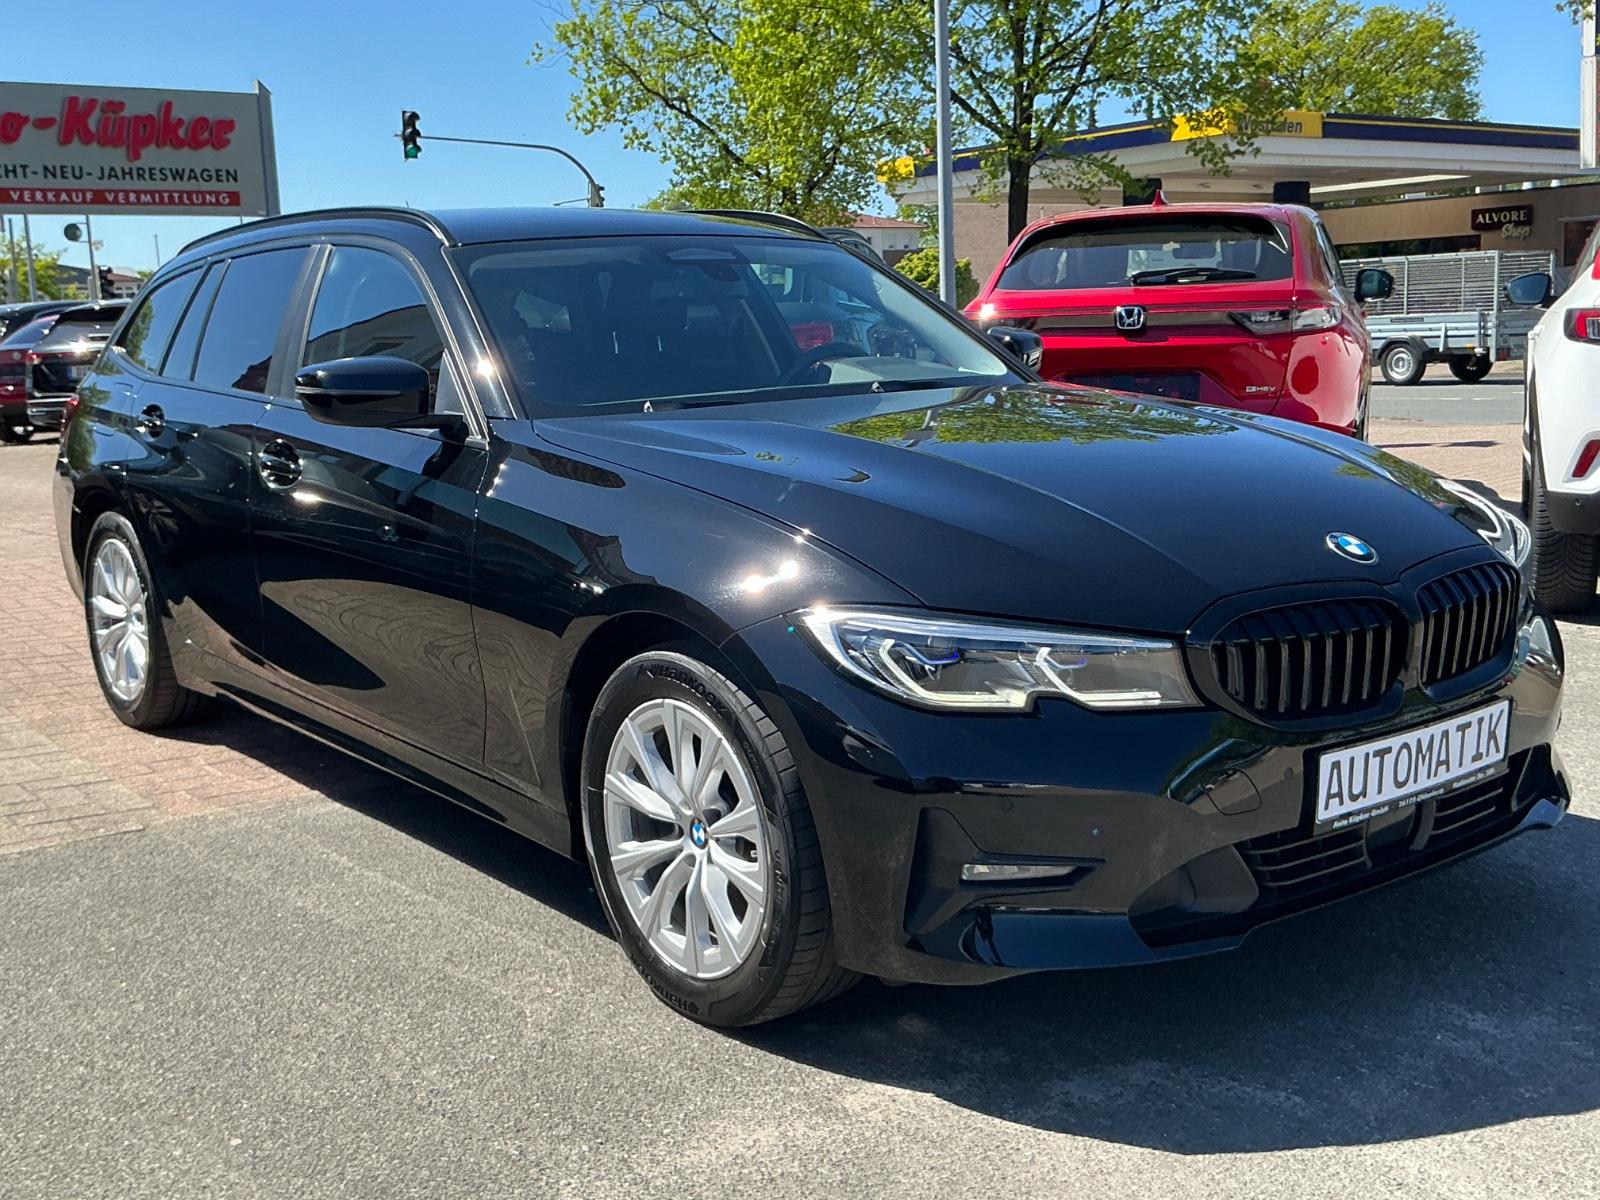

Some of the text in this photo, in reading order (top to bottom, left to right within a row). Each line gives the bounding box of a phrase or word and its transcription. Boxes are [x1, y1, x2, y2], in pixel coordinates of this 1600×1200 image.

[9, 190, 231, 204] VERKAUF VERMITTLUNG
[1476, 209, 1528, 224] ALVORE
[1324, 709, 1504, 811] AUTOMATIK
